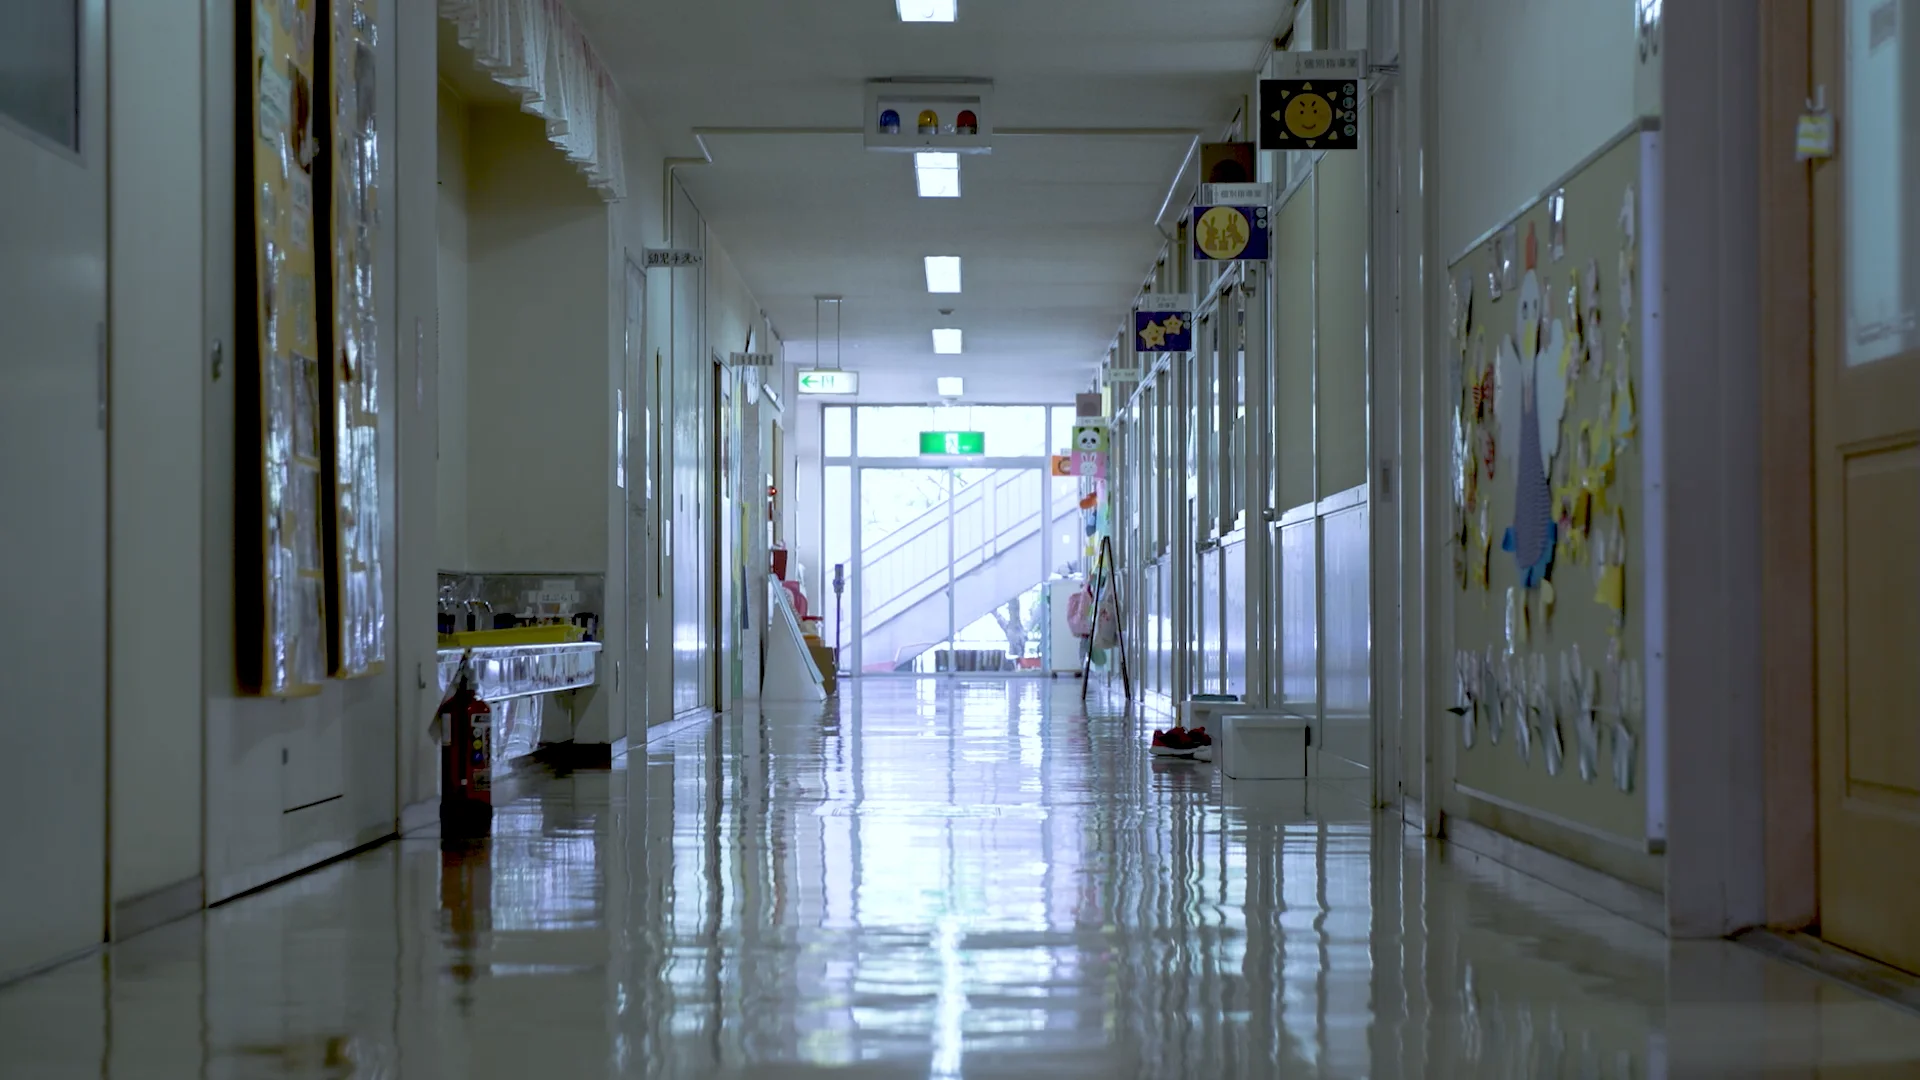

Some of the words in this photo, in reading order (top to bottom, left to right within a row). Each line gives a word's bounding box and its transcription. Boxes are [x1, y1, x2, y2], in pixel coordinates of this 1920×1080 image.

[648, 252, 702, 264] 幼児手洗い
